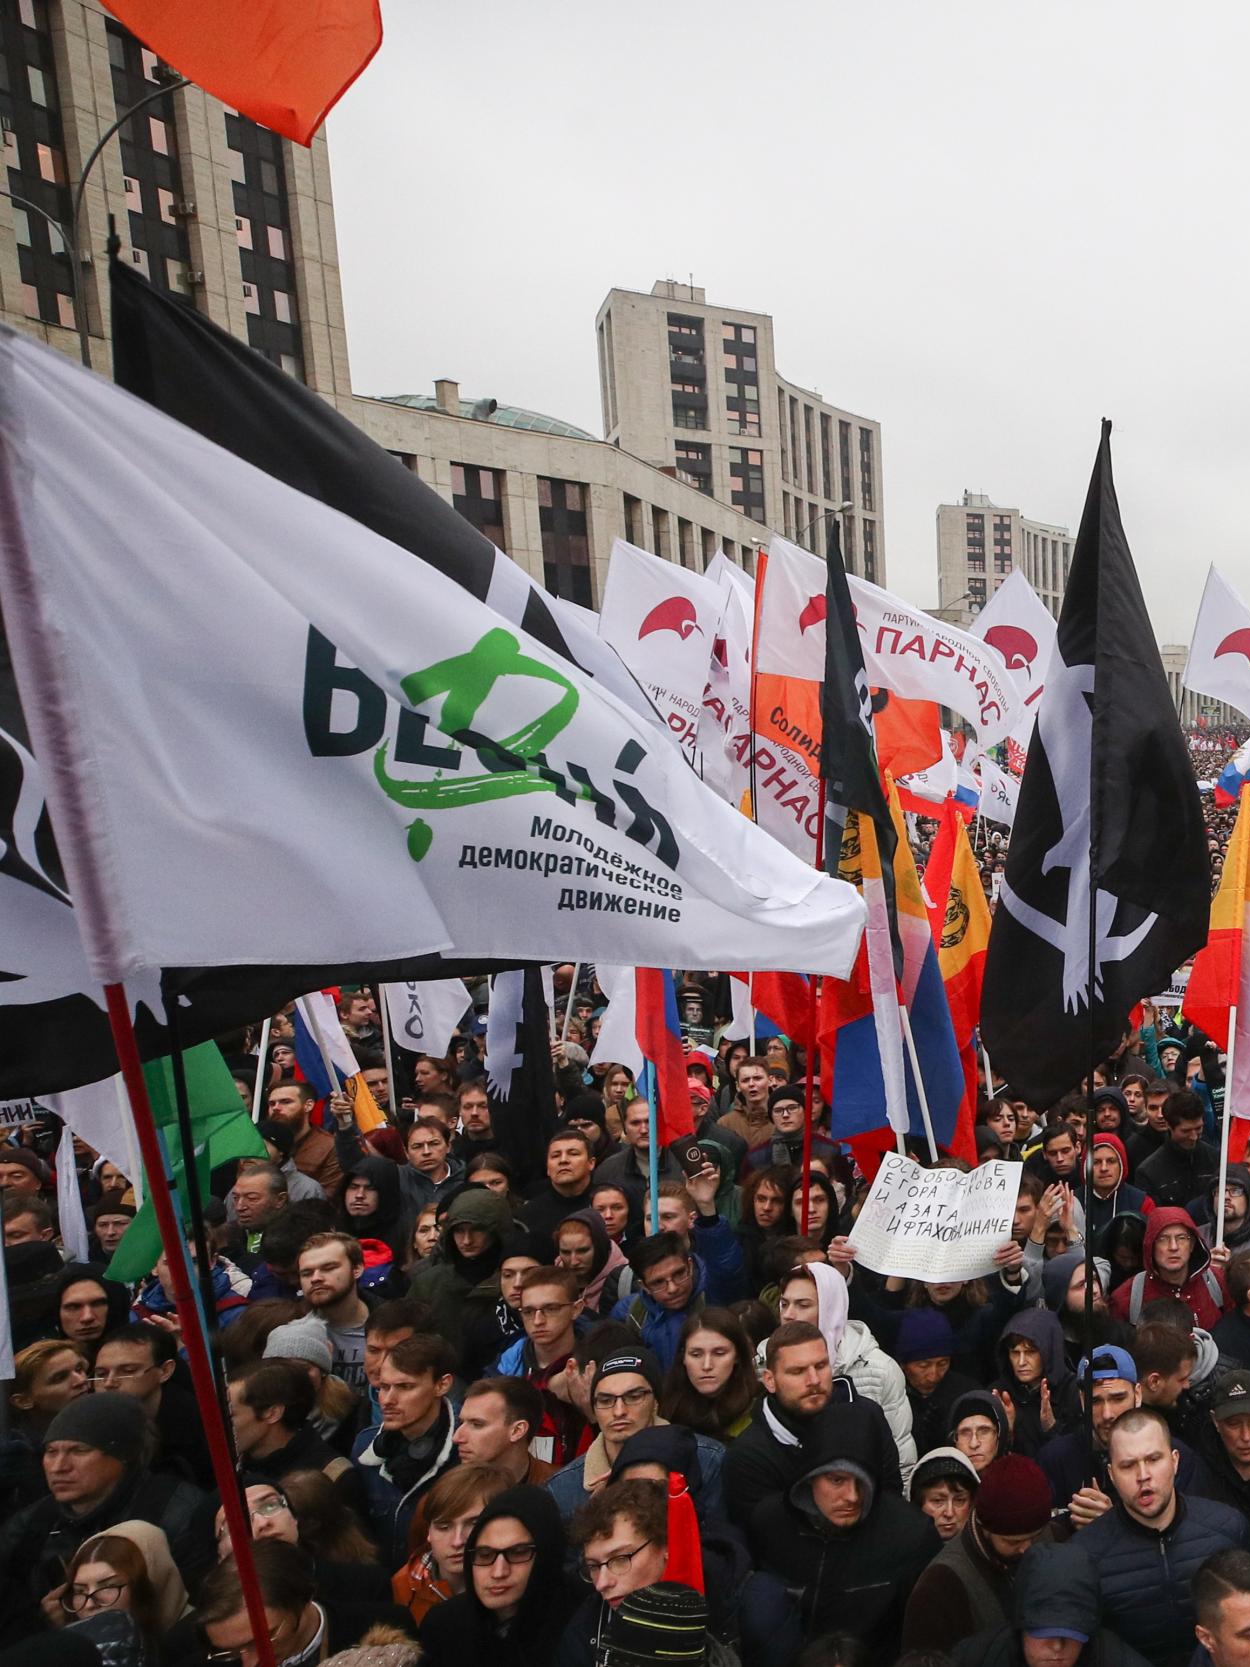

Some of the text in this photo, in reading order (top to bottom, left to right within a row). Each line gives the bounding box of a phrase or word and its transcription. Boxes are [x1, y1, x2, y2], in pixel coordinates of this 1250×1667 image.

[932, 631, 981, 664] АРОДНОЙ
[875, 626, 1001, 726] ПАРНАС
[669, 693, 700, 718] НАРОД
[770, 706, 823, 762] Солид
[730, 725, 819, 839] АРНАС
[530, 815, 683, 895] Молодёжное
[558, 888, 682, 923] движение
[883, 1172, 938, 1198] ЕГОРА
[896, 1201, 958, 1222] АЗАТА
